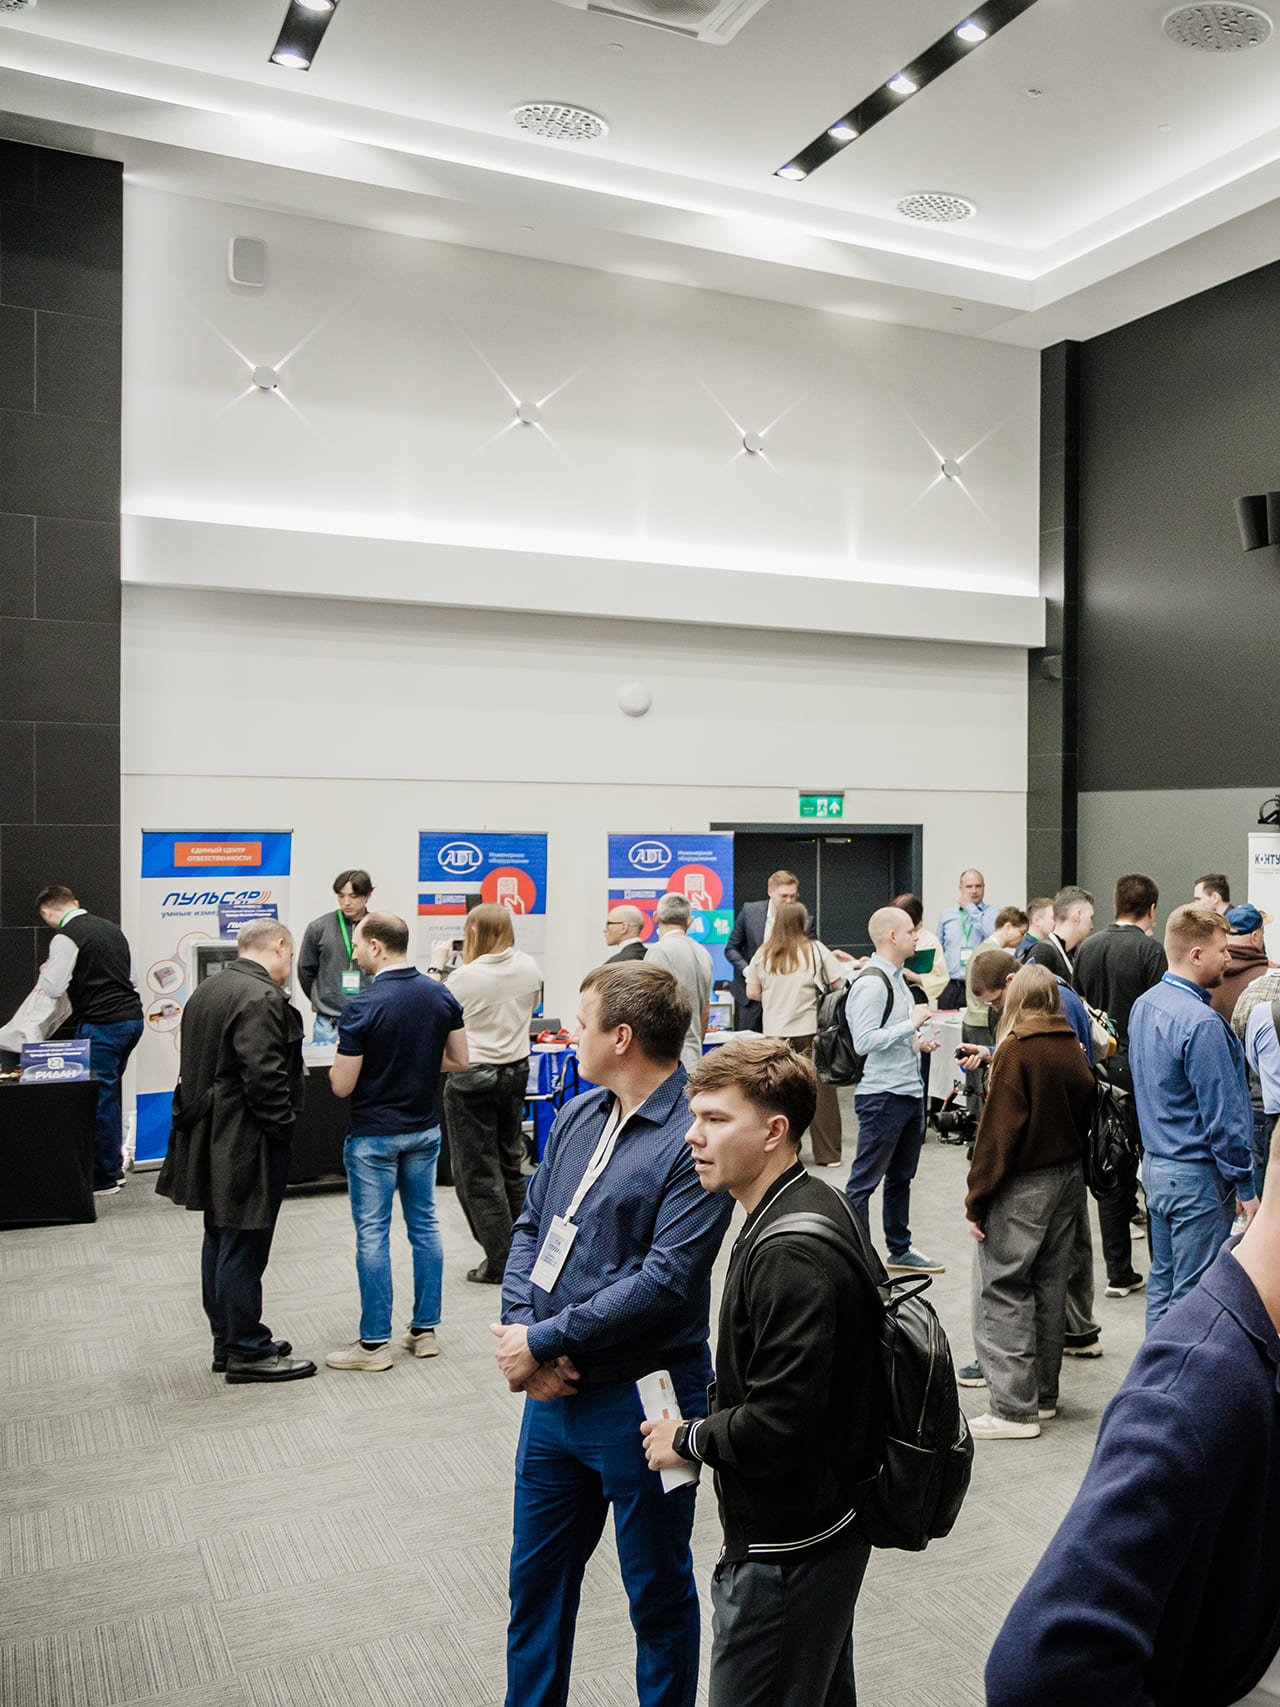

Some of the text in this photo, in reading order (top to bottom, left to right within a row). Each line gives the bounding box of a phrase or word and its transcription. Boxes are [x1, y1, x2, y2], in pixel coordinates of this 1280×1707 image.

[191, 846, 222, 854] ЕДИНЫЙ
[443, 850, 480, 866] ADL
[632, 849, 668, 864] ADL
[35, 1070, 76, 1079] РИДАН
